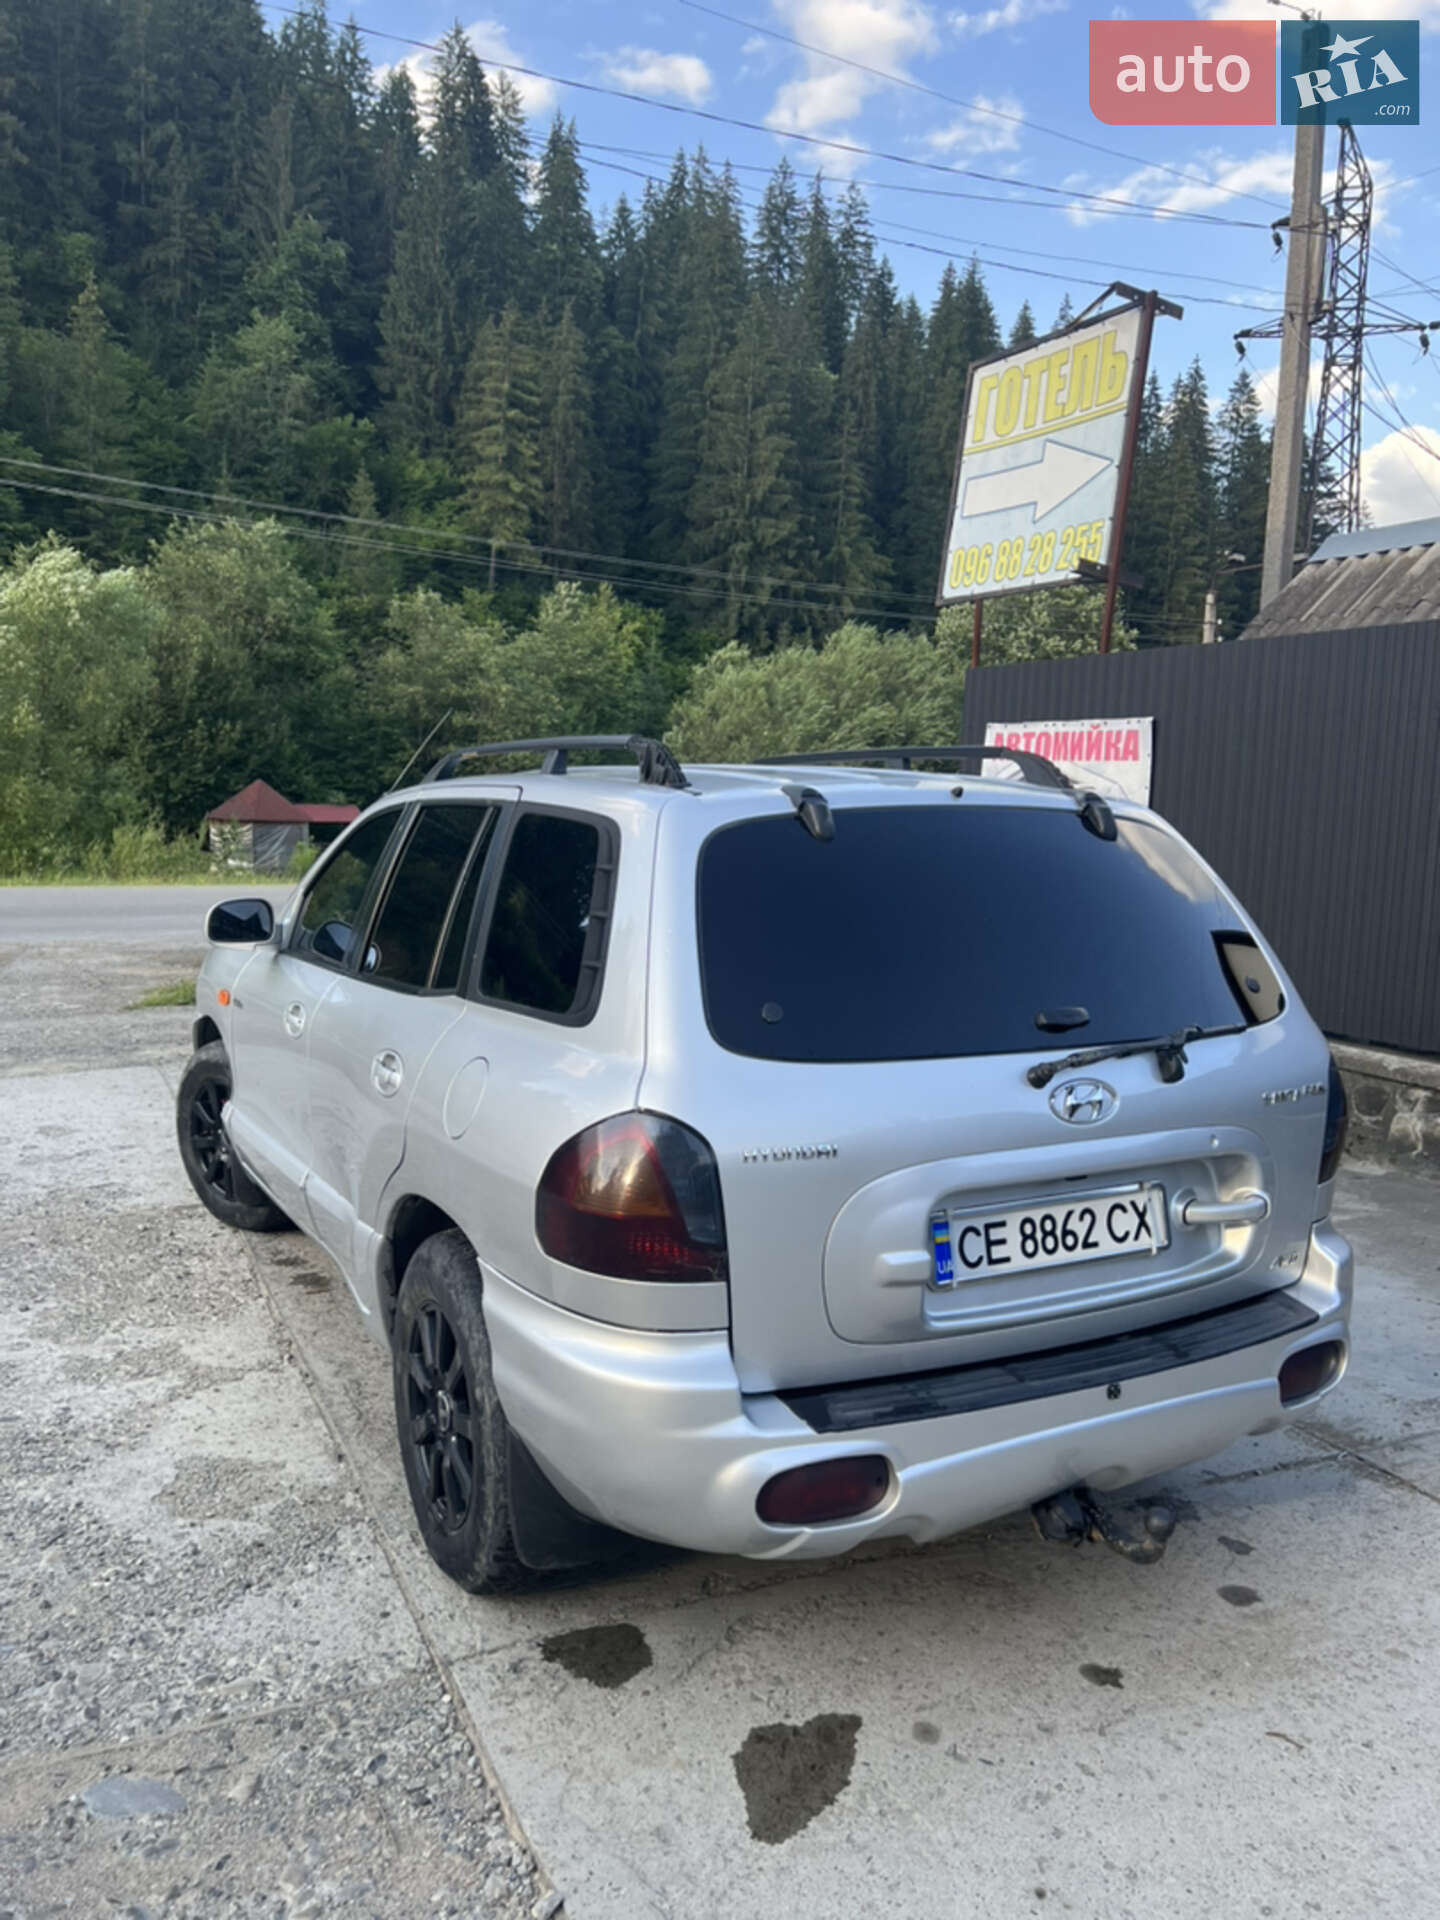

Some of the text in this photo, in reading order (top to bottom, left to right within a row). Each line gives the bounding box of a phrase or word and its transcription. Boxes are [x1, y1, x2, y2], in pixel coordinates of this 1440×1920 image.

[971, 329, 1129, 444] ГОТЕЛЬ
[949, 519, 1105, 588] 096 88 28 255
[957, 1199, 1154, 1269] CE 8862 CX
